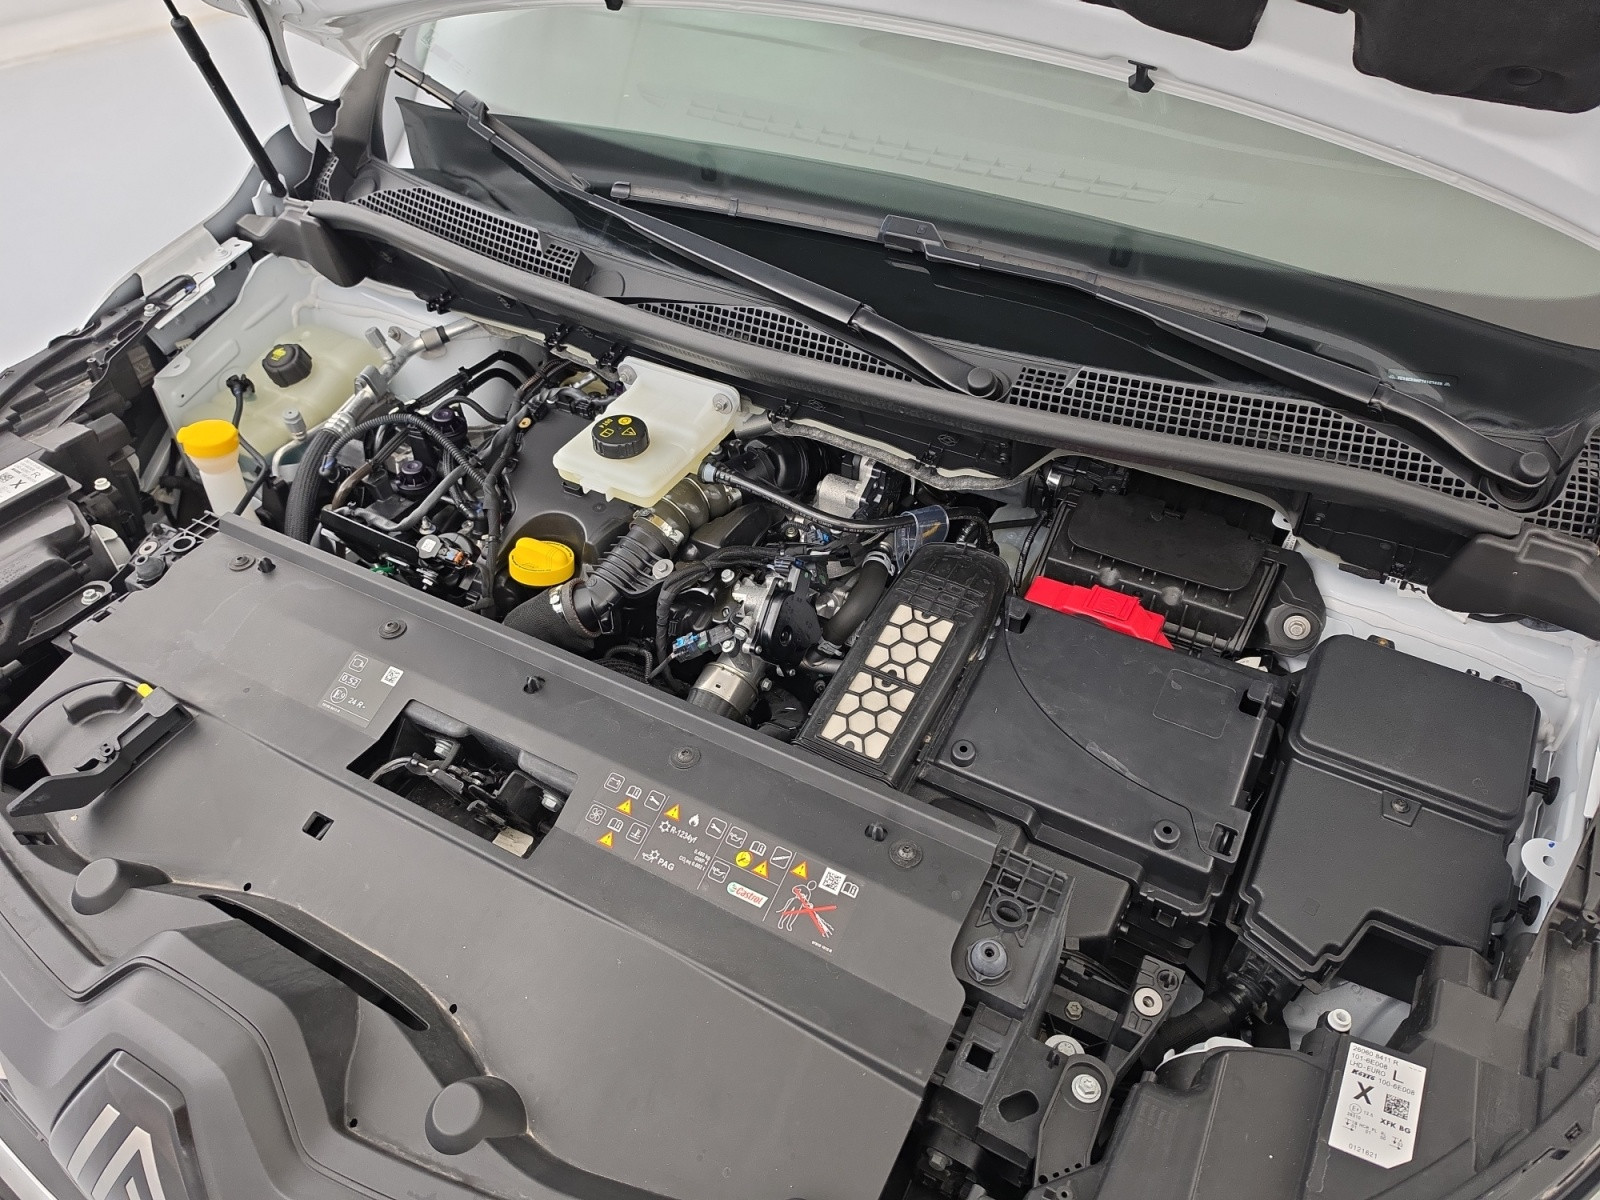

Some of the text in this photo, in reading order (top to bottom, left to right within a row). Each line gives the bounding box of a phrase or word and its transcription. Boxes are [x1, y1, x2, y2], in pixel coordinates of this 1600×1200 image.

[341, 674, 358, 686] 0.52
[670, 826, 698, 844] R-1234yf
[657, 857, 675, 871] PAG
[735, 886, 763, 905] Castrol
[1392, 1070, 1404, 1084] L
[1353, 1081, 1375, 1105] X
[1380, 1118, 1411, 1134] XFK BG
